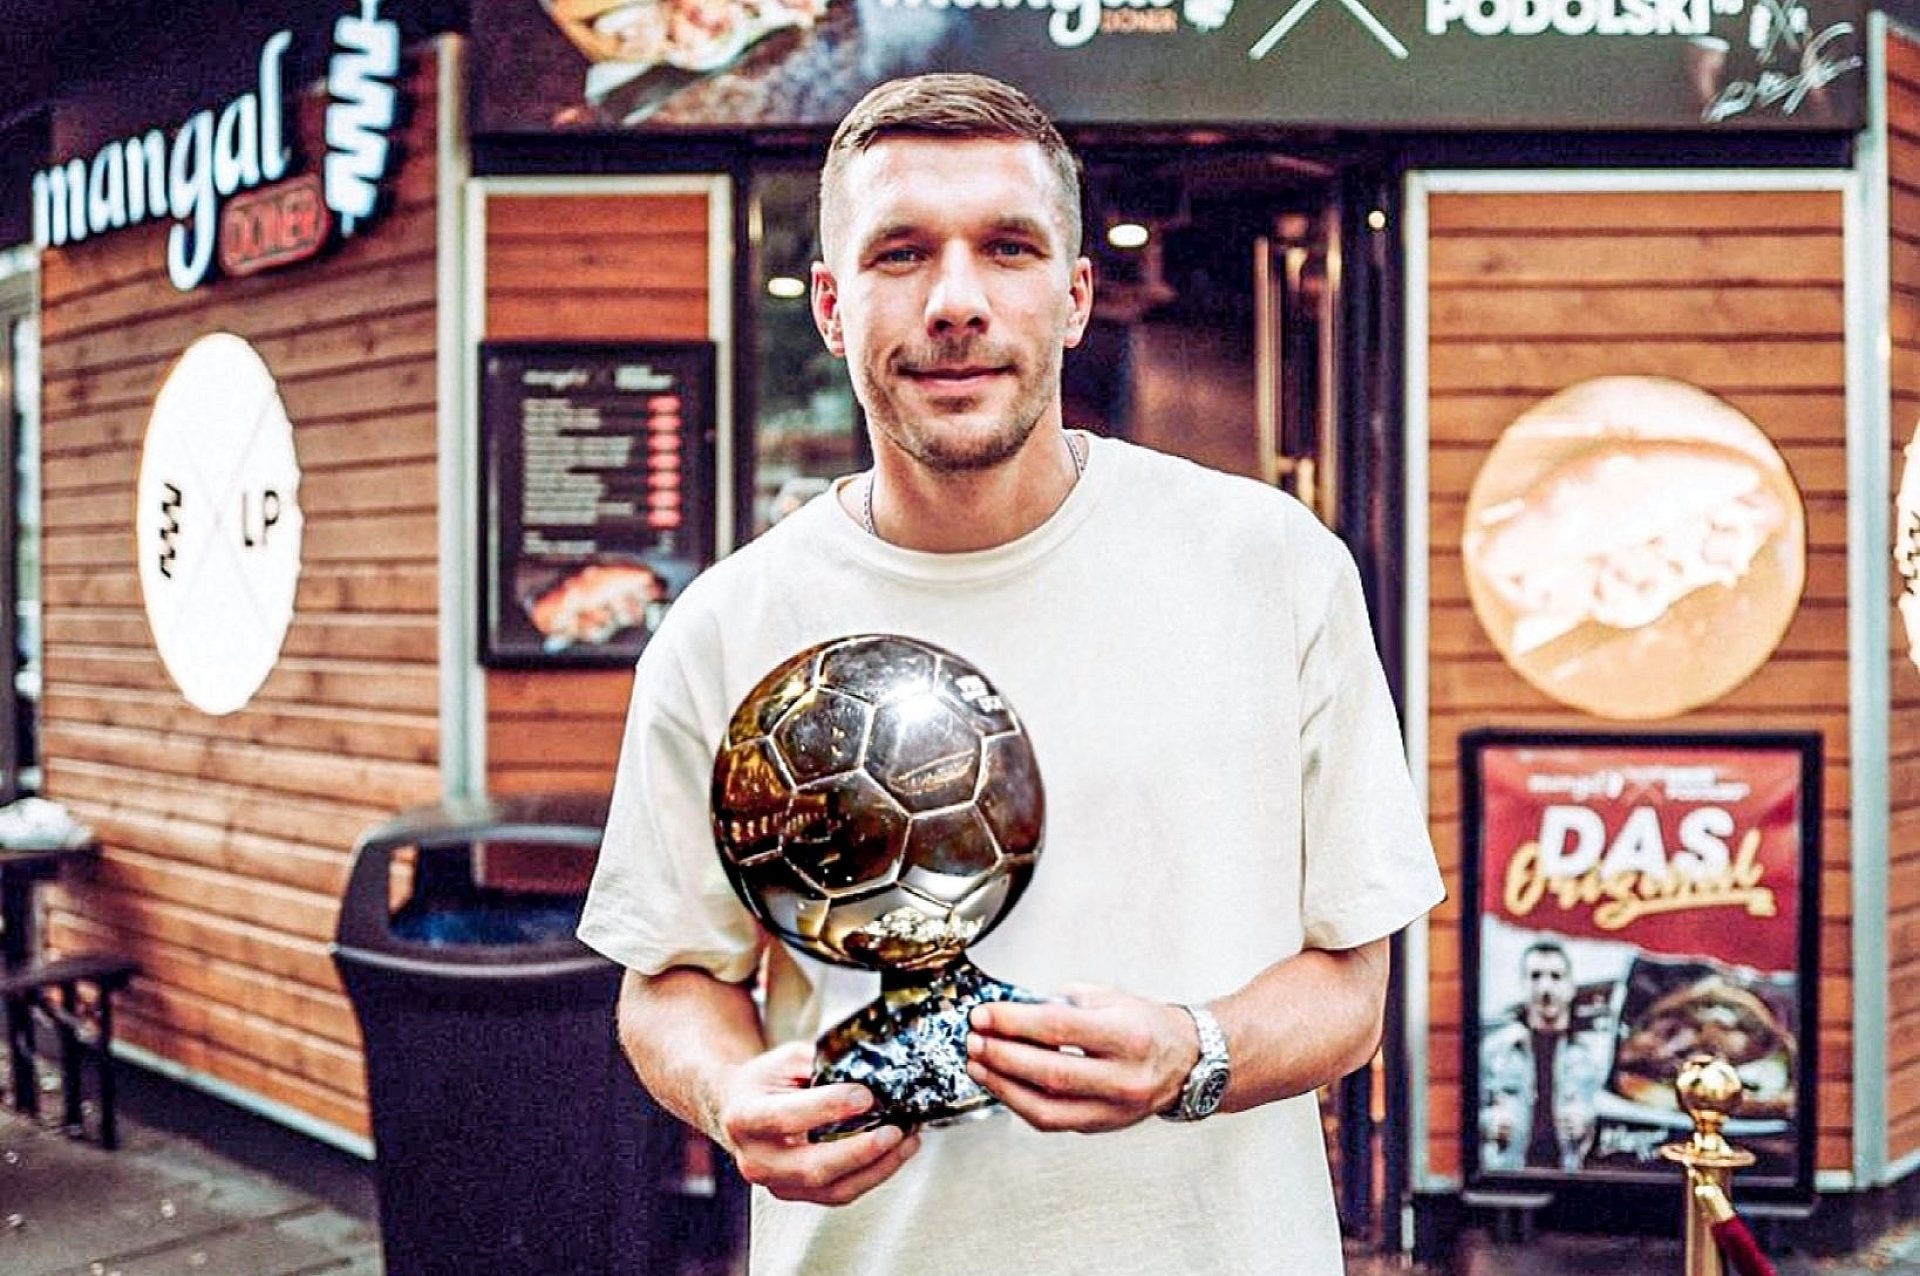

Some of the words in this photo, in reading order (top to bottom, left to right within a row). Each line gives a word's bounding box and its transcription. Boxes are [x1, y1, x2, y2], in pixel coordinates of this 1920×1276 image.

[1425, 0, 1712, 35] PODOLSKI
[32, 30, 292, 291] mangal
[1540, 804, 1735, 881] DAS
